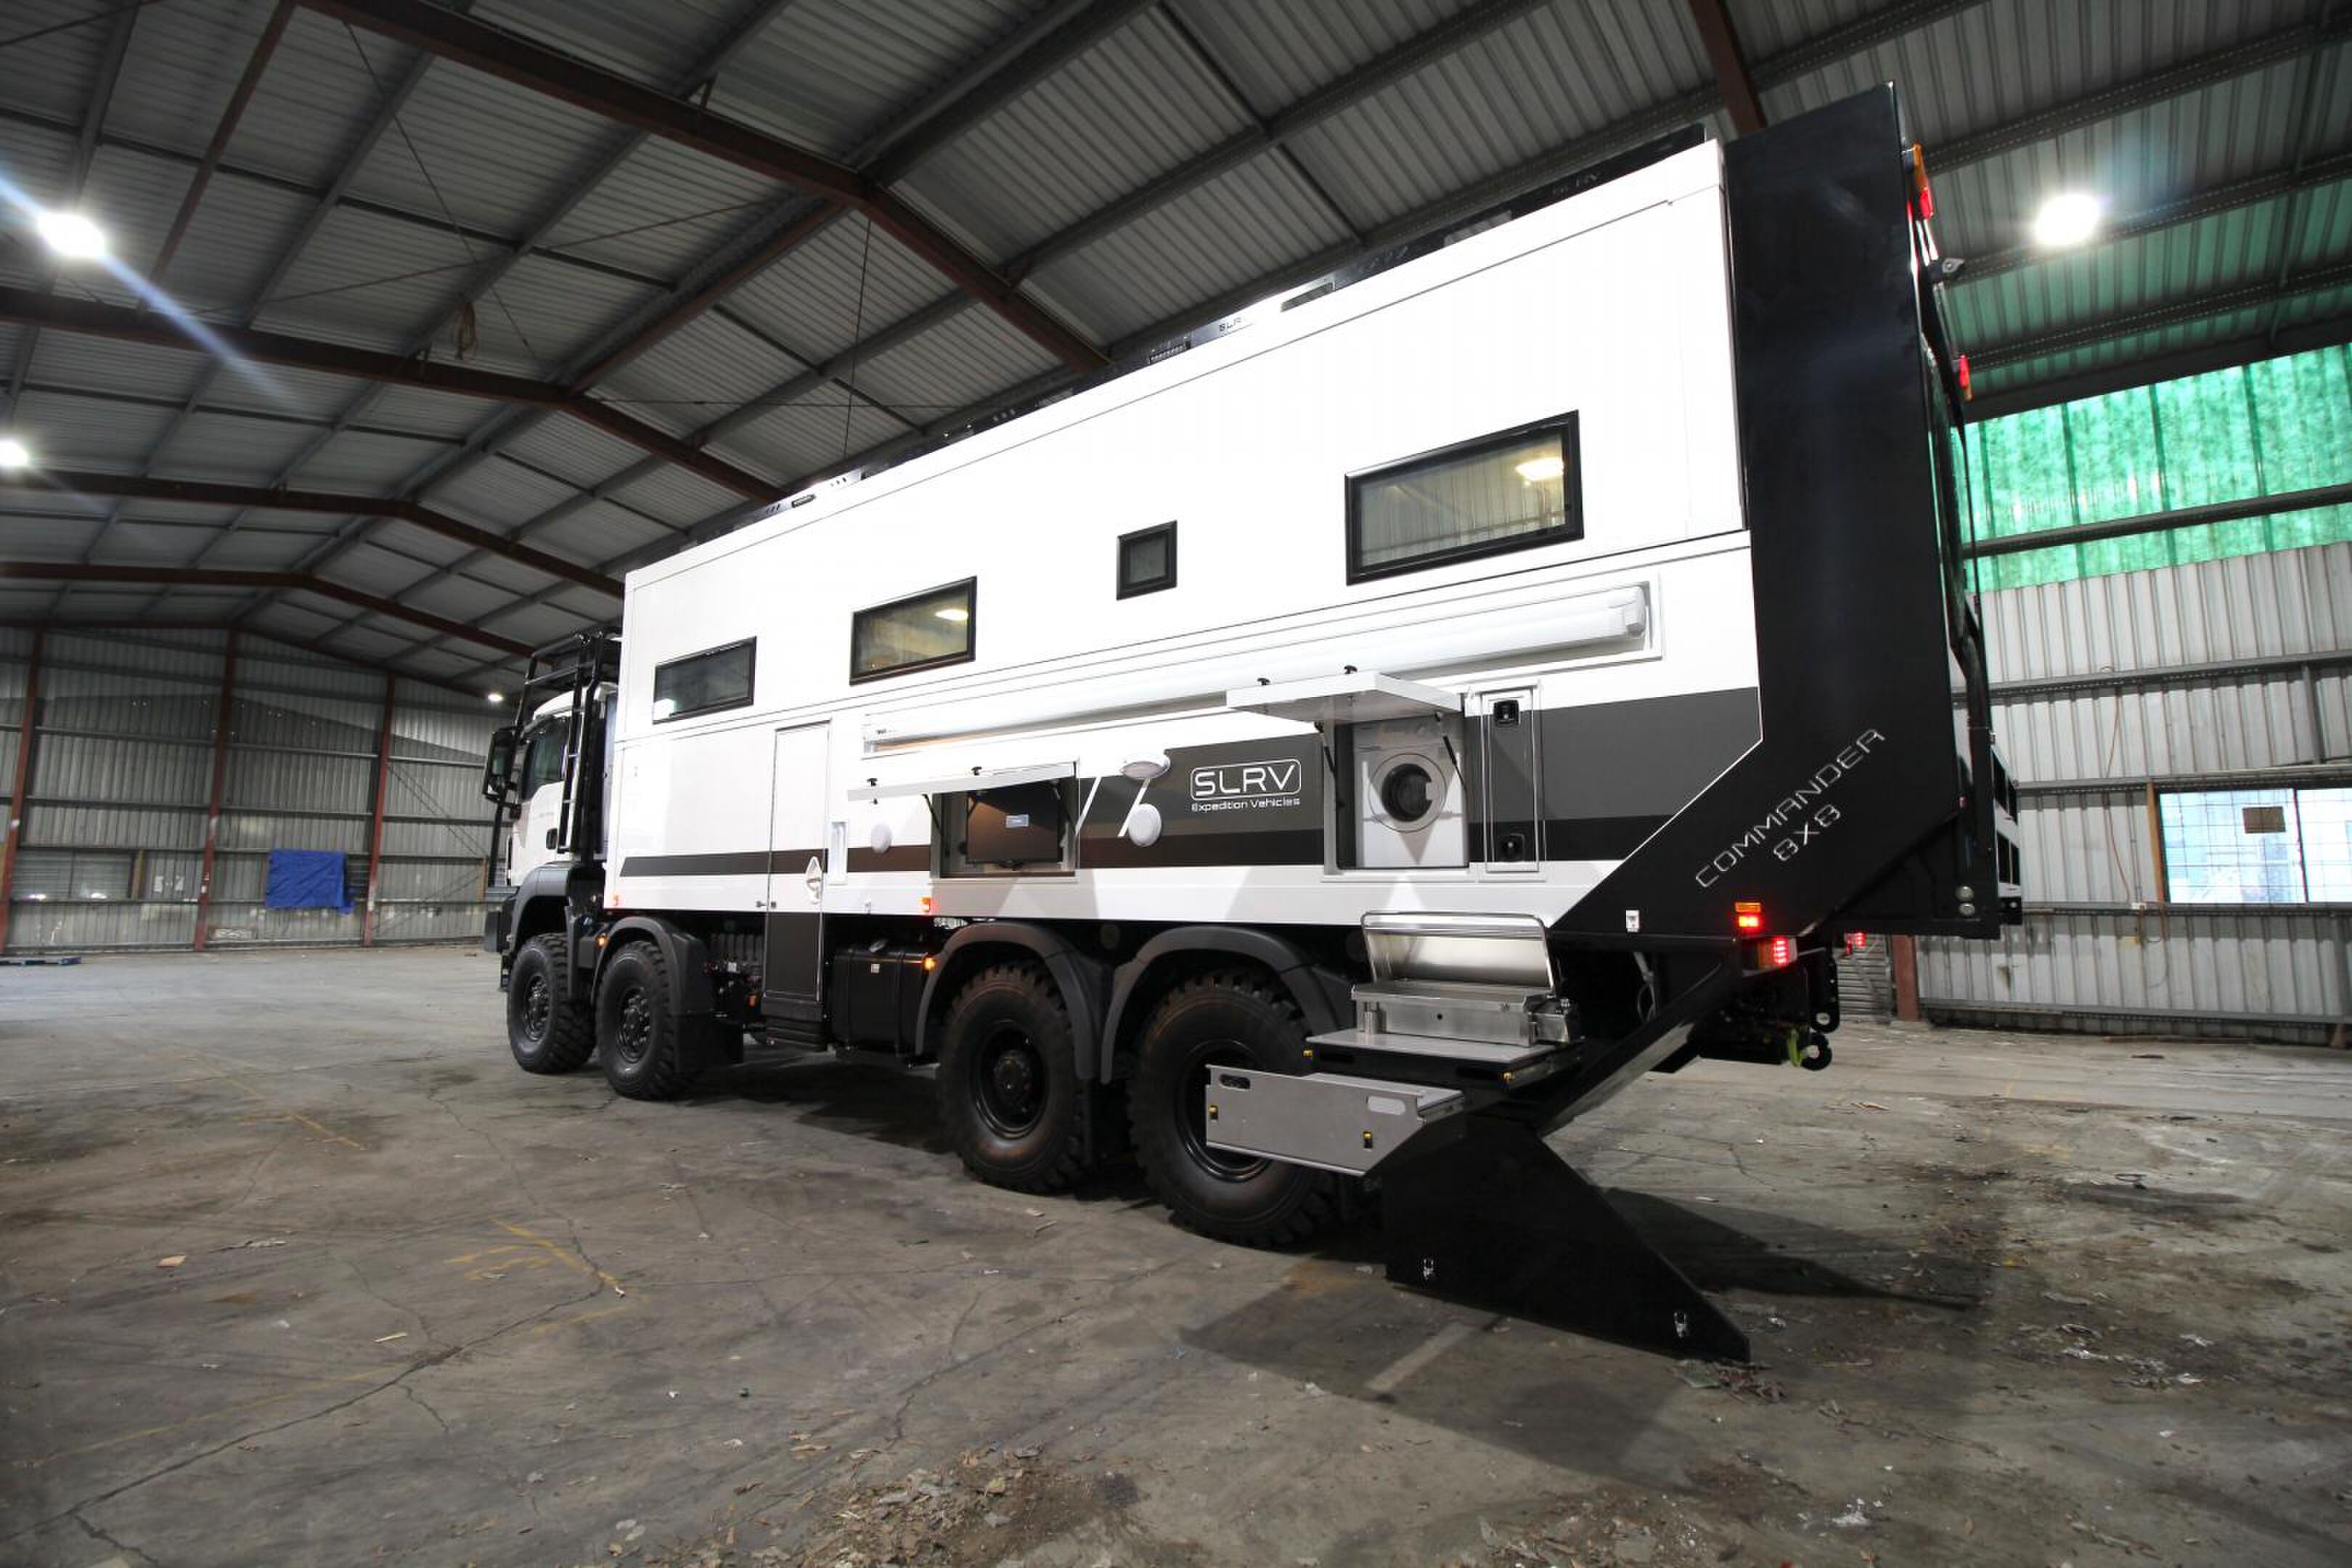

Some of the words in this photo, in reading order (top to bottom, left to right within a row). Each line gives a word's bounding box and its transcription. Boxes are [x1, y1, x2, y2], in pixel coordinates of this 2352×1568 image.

[1194, 764, 1296, 796] SLRV
[1191, 801, 1248, 812] Expedition
[1250, 797, 1301, 808] Vehicles
[1695, 729, 1885, 887] COMMANDER
